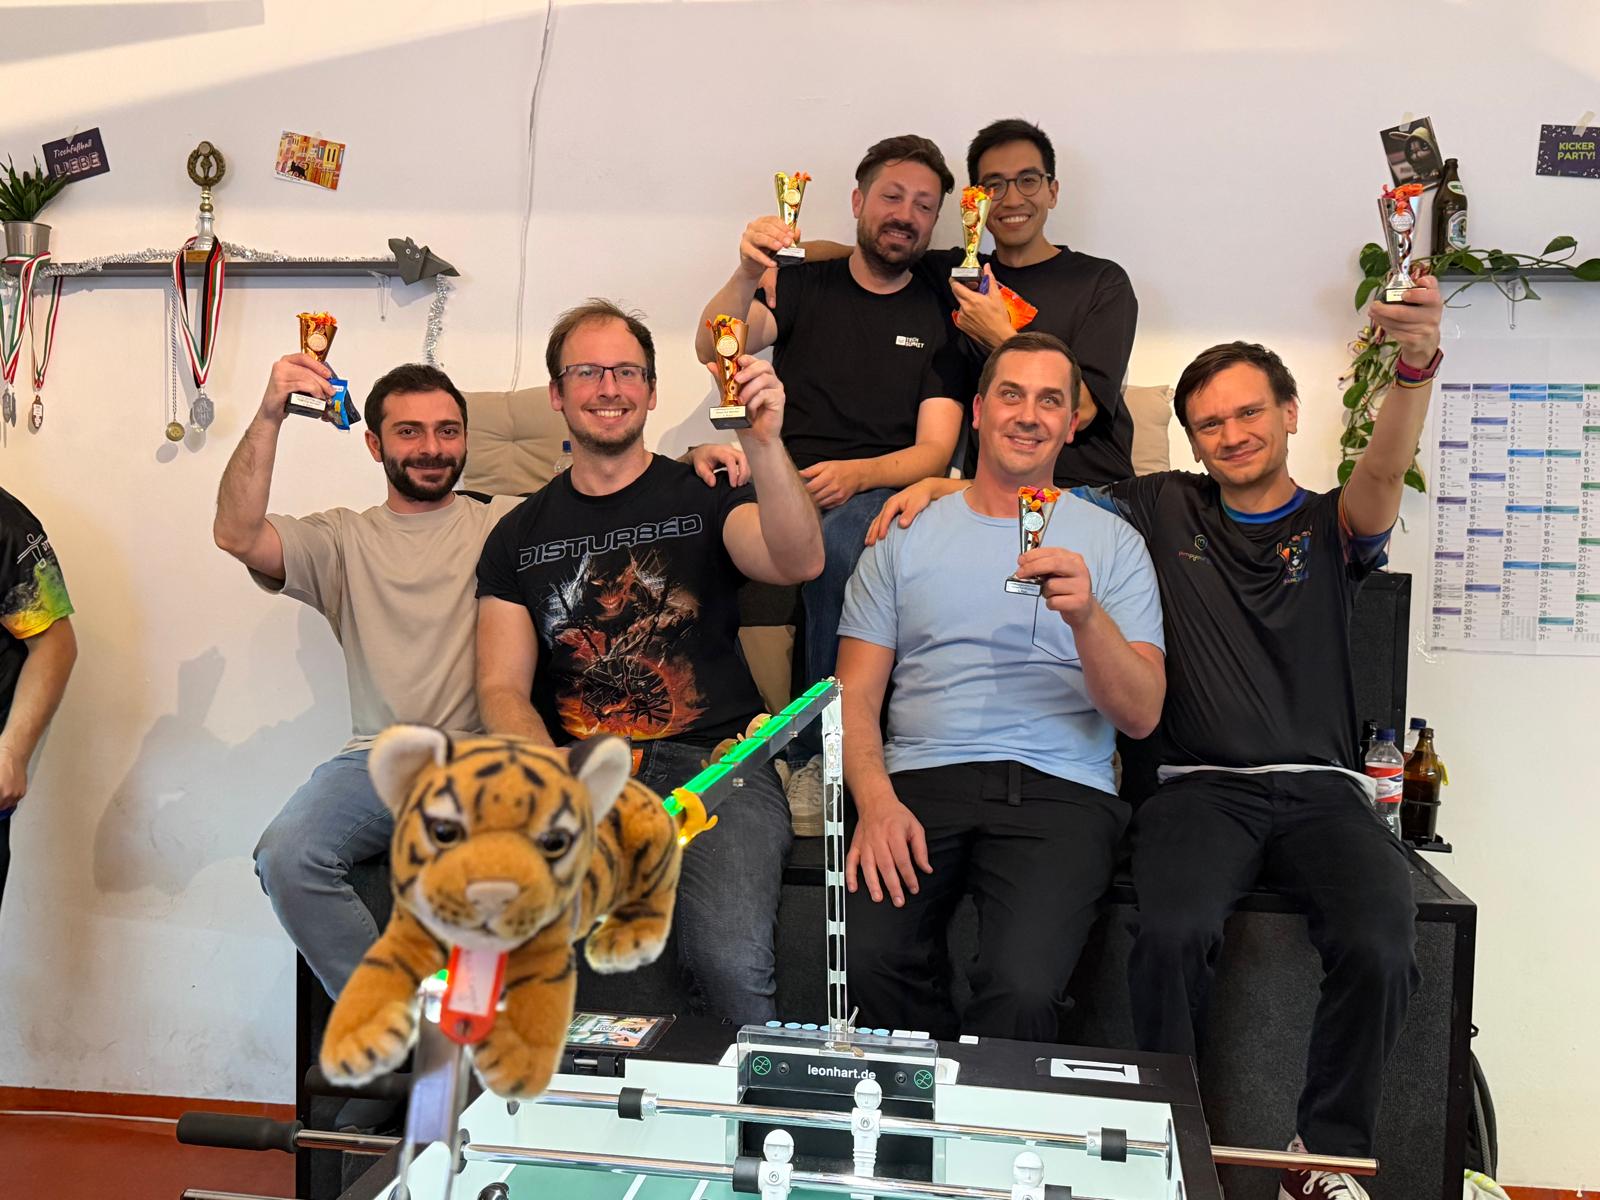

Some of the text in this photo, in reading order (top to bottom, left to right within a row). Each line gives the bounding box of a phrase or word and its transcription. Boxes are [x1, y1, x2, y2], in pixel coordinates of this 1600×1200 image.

[53, 138, 93, 158] Tischfußball
[1559, 142, 1595, 150] KICKER
[54, 152, 101, 178] LIEBE
[1558, 152, 1596, 160] PARTY!
[516, 513, 703, 572] DISTURBED
[808, 1064, 876, 1080] leonhart.de
